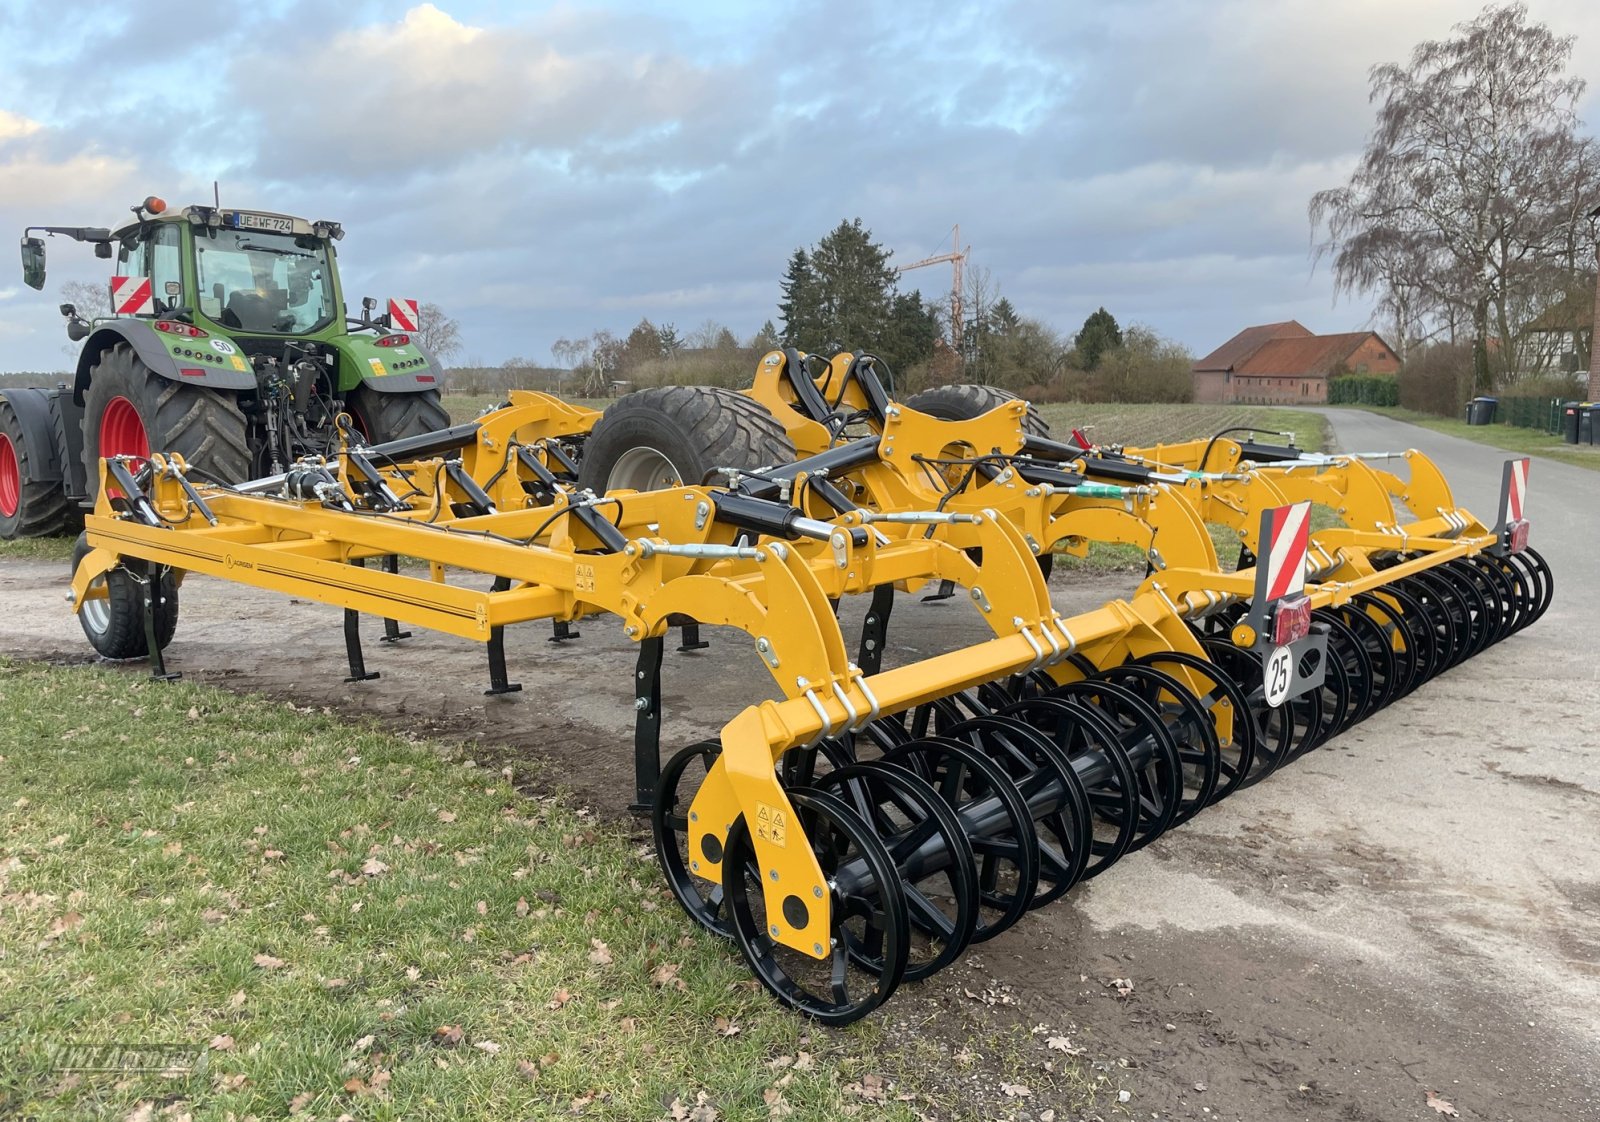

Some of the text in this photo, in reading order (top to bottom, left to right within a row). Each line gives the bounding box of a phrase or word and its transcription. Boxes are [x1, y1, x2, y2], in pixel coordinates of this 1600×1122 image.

[240, 215, 291, 231] UE WF 724
[213, 340, 232, 353] 50
[1270, 654, 1289, 698] 25
